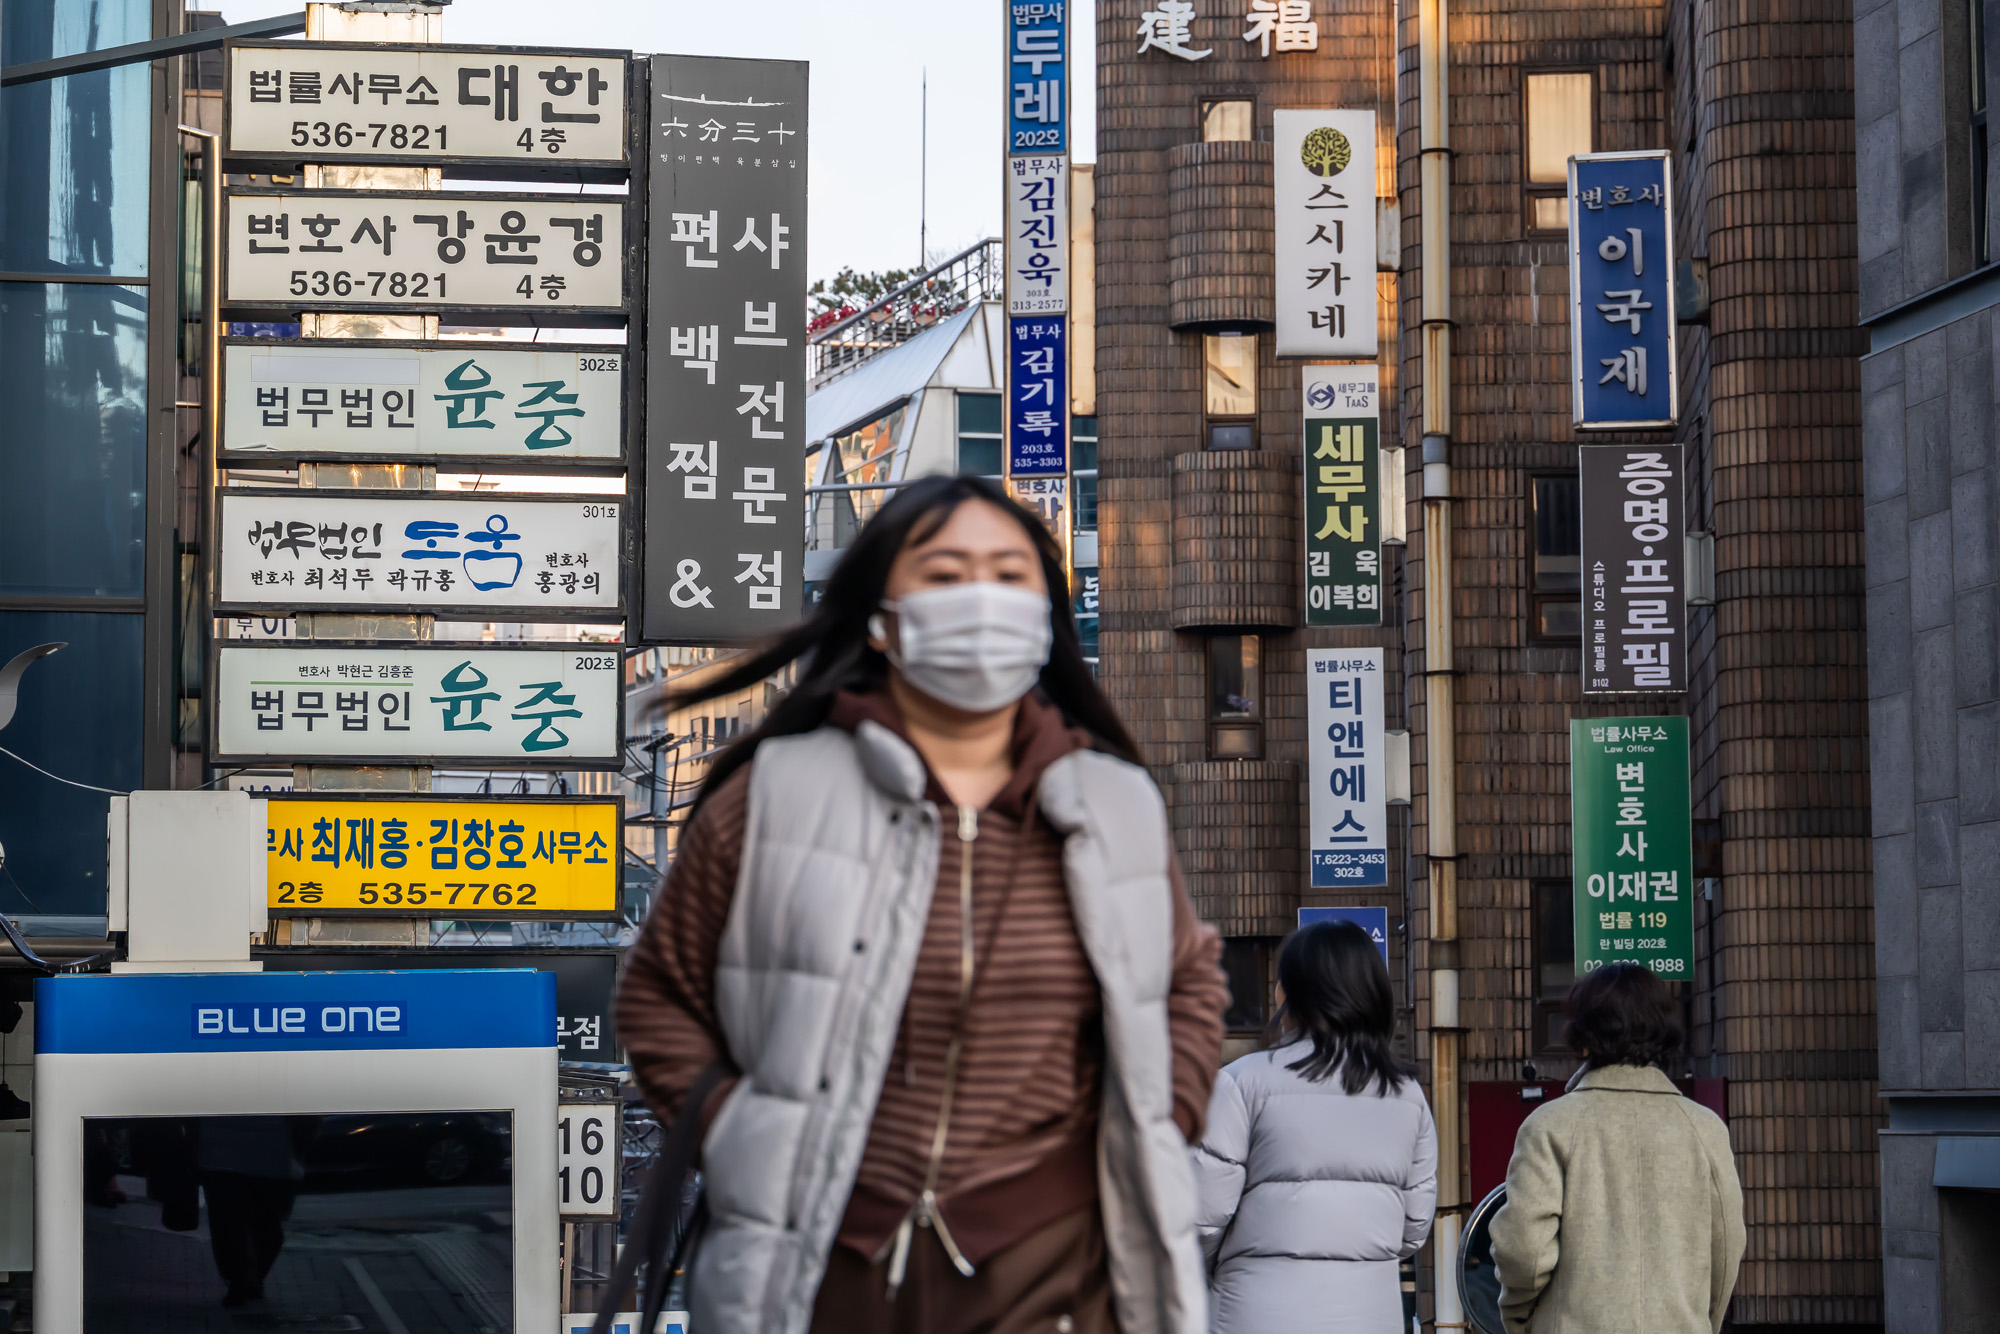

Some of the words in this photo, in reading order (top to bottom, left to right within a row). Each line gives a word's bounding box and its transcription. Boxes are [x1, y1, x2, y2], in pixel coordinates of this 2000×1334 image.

[1013, 2, 1063, 25] 법무사
[1013, 29, 1062, 123] 두레
[249, 69, 439, 106] 법률사무소
[457, 64, 608, 124] 대한
[290, 121, 447, 150] 536-7821
[516, 127, 566, 154] 4층
[661, 116, 796, 146] 六分三十
[1015, 129, 1060, 147] 202호
[1013, 157, 1063, 176] 법무사
[1581, 183, 1664, 210] 변호사
[247, 212, 397, 256] 변호사
[412, 209, 603, 267] 강윤경
[1017, 177, 1061, 287] 김진욱
[1304, 183, 1351, 339] 스시카네
[289, 270, 447, 298] 536-7821
[515, 273, 566, 301] 4층
[1012, 299, 1064, 311] 313-2577
[1596, 227, 1653, 396] 이국재
[1015, 324, 1062, 340] 법무사
[579, 358, 620, 373] 302호
[666, 210, 718, 500] 편백찜
[256, 386, 415, 428] 법무법인
[433, 358, 586, 450] 윤중
[1017, 346, 1059, 438] 김기록
[732, 212, 789, 609] 샤브전문점
[1021, 443, 1055, 454] 203호
[1014, 456, 1063, 468] 535-3303
[1313, 425, 1369, 542] 세무사
[582, 505, 617, 519] 301호
[248, 519, 383, 561] 법무법인
[401, 513, 523, 592] 도움
[545, 552, 589, 569] 변호사
[250, 570, 295, 586] 변호사
[304, 567, 375, 591] 최석두
[386, 568, 456, 592] 곽규홍
[534, 571, 601, 596] 홍광의
[669, 558, 714, 608] &
[1593, 560, 1605, 611] 스튜디오
[1309, 584, 1378, 610] 이복희
[299, 665, 330, 678] 변호사
[337, 664, 373, 678] 박현근
[378, 665, 413, 679] 김흥준
[575, 656, 616, 671] 202호
[1314, 659, 1376, 673] 법률사무소
[1592, 678, 1609, 687] B102
[251, 689, 411, 732] 법무법인
[429, 660, 583, 753] 윤중
[1590, 726, 1668, 743] 법률사무소
[1327, 677, 1368, 843] 티앤에스
[1604, 745, 1623, 753] Law
[1626, 744, 1654, 753] Office
[1615, 761, 1648, 862] 변호사
[532, 830, 609, 866] 사무소
[1334, 867, 1365, 878] 302호
[277, 881, 324, 904] 2층
[358, 882, 537, 906] 535-7762
[1587, 870, 1679, 902] 이재권
[1600, 912, 1633, 929] 법률
[1638, 912, 1667, 928] 119
[1613, 938, 1634, 950] 빌딩
[1637, 938, 1667, 949] 202호
[1648, 958, 1684, 972] 1988
